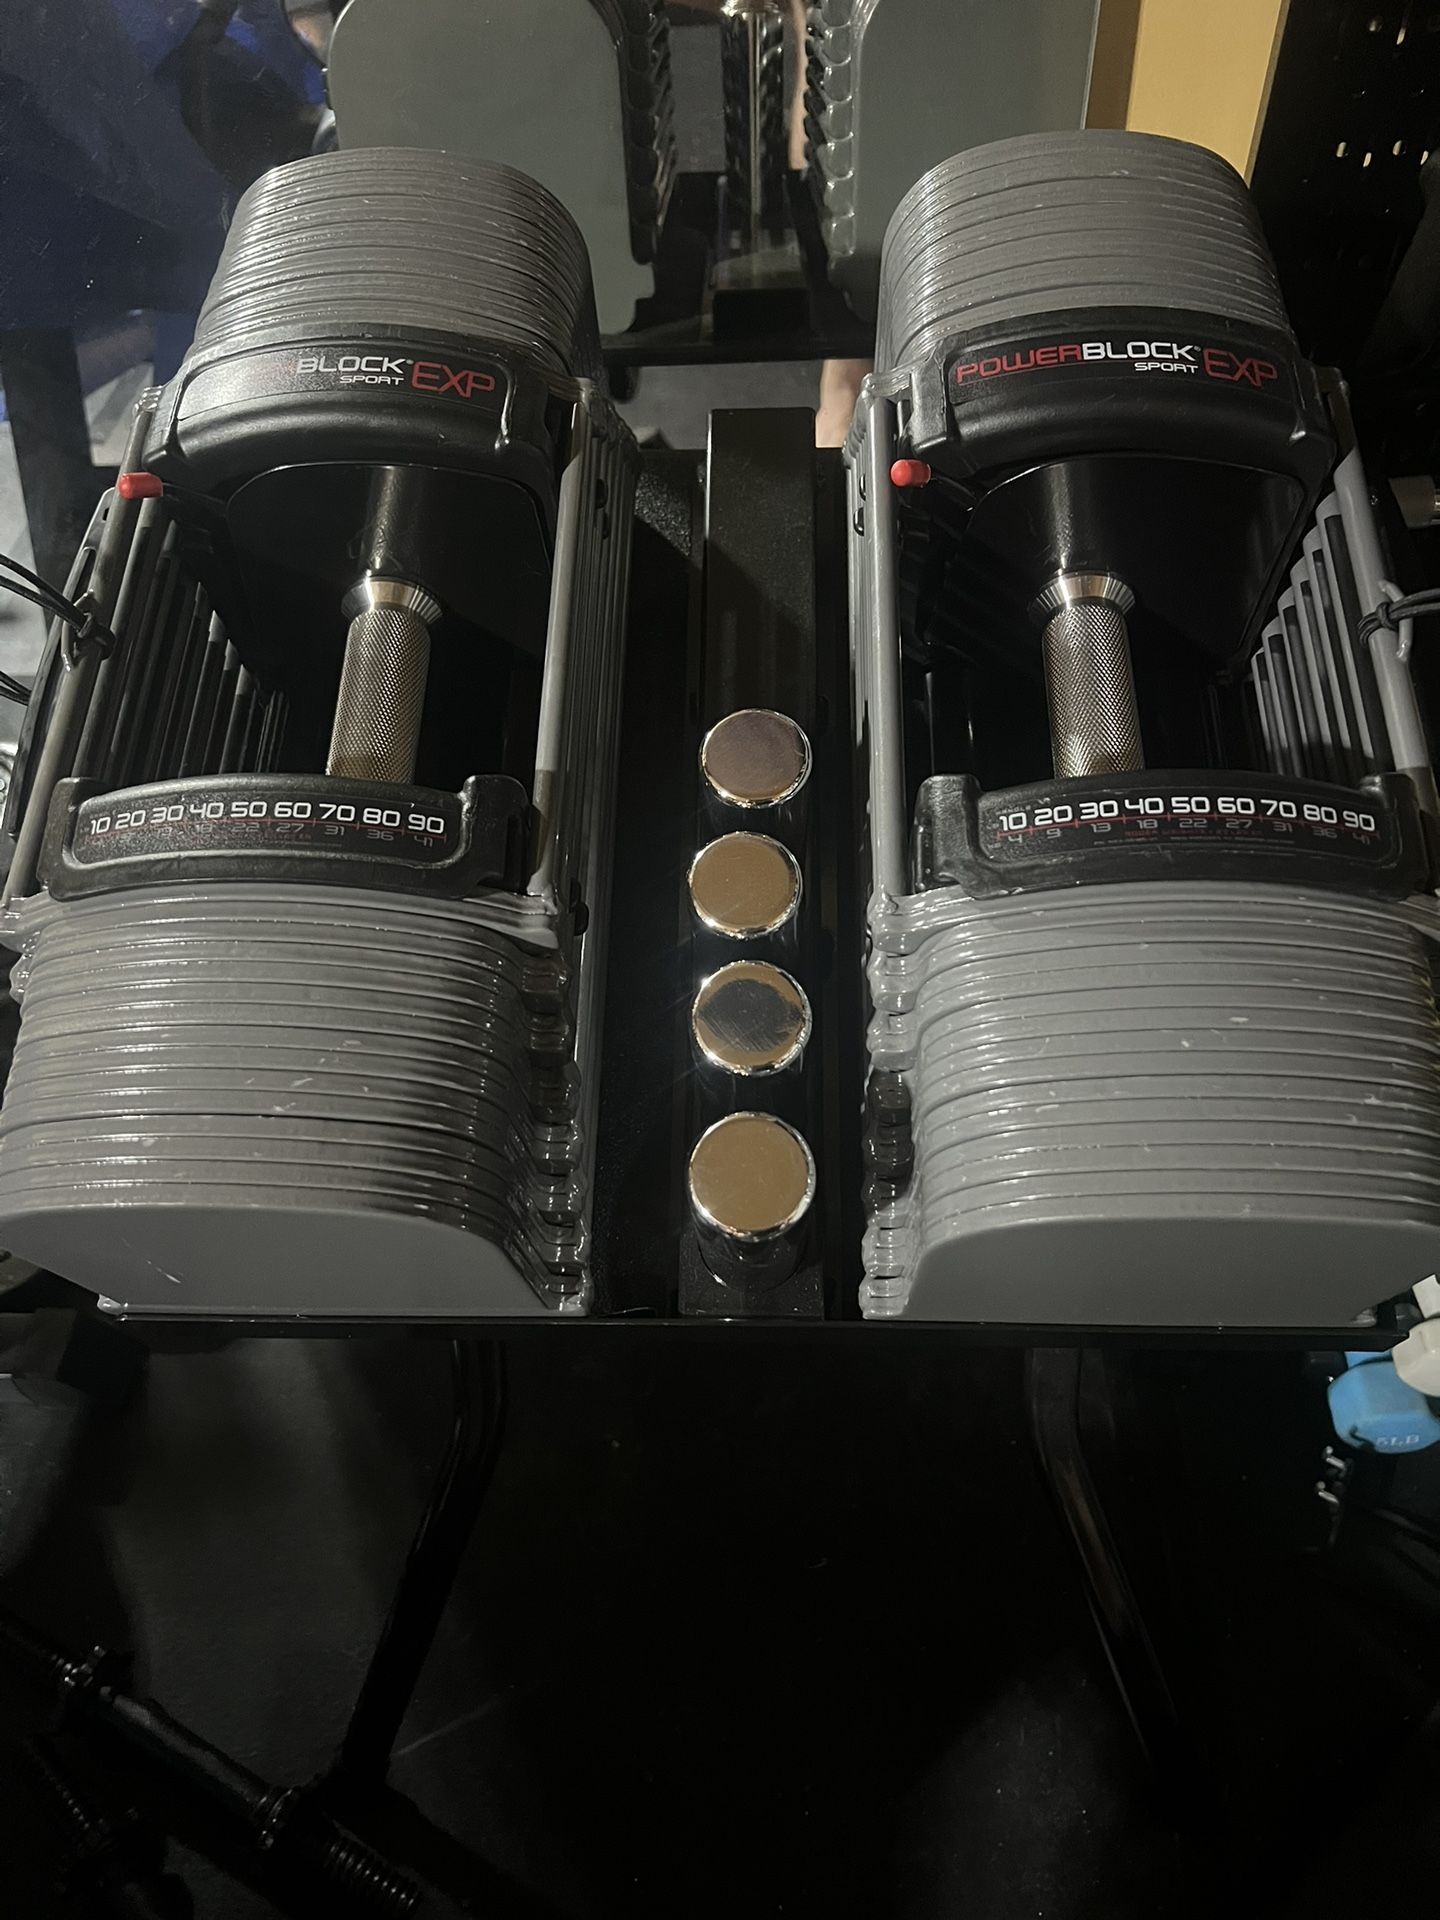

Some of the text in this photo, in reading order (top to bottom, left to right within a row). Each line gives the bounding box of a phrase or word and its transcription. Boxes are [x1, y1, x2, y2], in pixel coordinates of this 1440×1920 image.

[339, 375, 405, 386] SPORT
[411, 361, 496, 398] EXP
[1134, 361, 1199, 374] SPORT
[1202, 348, 1277, 387] EXP
[91, 816, 111, 835] 10
[115, 809, 146, 830] 20
[150, 805, 184, 824] 30
[190, 802, 225, 819] 40
[230, 801, 267, 818] 50
[274, 801, 312, 819] 60
[319, 803, 356, 822] 70
[362, 807, 401, 827] 80
[408, 813, 444, 834] 90
[999, 796, 1375, 832] 10 20 30 40 50 60 70 80 90
[231, 822, 260, 833] 22
[276, 822, 305, 833] 27
[324, 824, 345, 836] 31
[367, 829, 394, 841] 36
[414, 836, 433, 847] 41
[1008, 833, 1023, 844] 4
[1047, 828, 1062, 839] 9
[1090, 822, 1112, 833] 13
[1136, 819, 1158, 830] 18
[1179, 818, 1208, 829] 22
[1225, 818, 1252, 829] 27
[1273, 821, 1293, 833] 31
[1311, 826, 1338, 839] 36
[1352, 832, 1371, 846] 41
